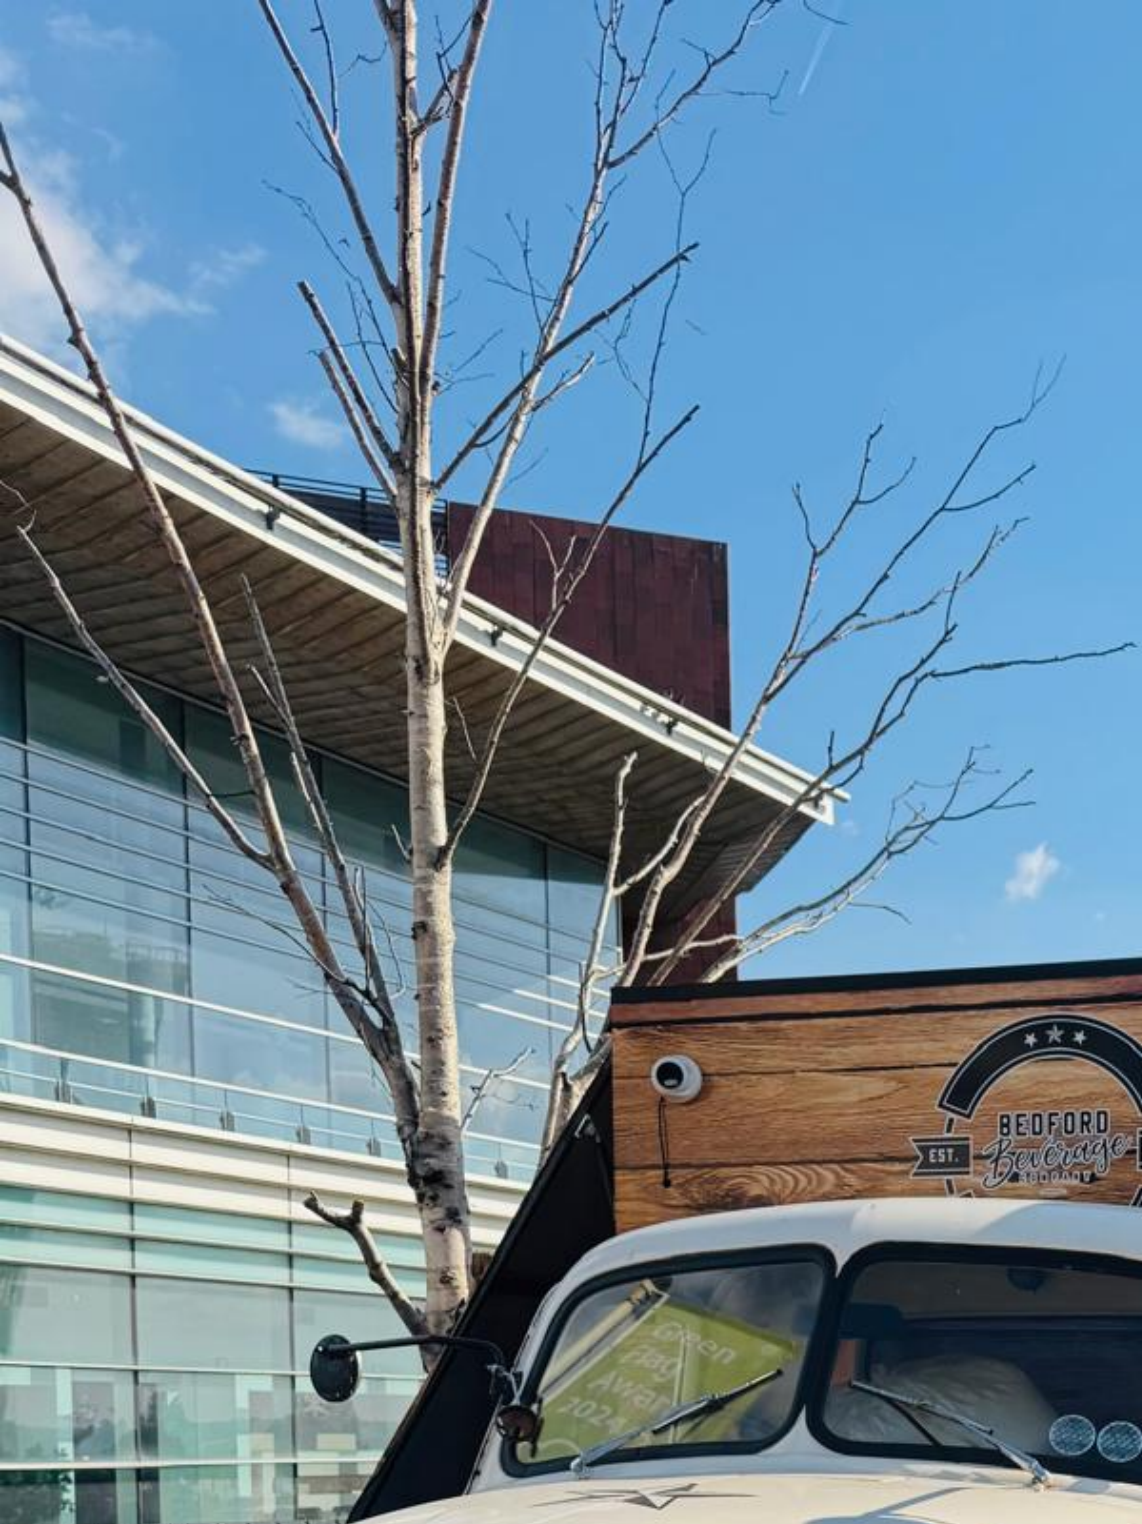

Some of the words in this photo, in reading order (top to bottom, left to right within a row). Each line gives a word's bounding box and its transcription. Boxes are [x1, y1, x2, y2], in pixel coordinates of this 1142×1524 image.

[998, 1109, 1109, 1137] BEDFORD
[928, 1148, 960, 1164] EST.
[982, 1132, 1128, 1189] Beverage
